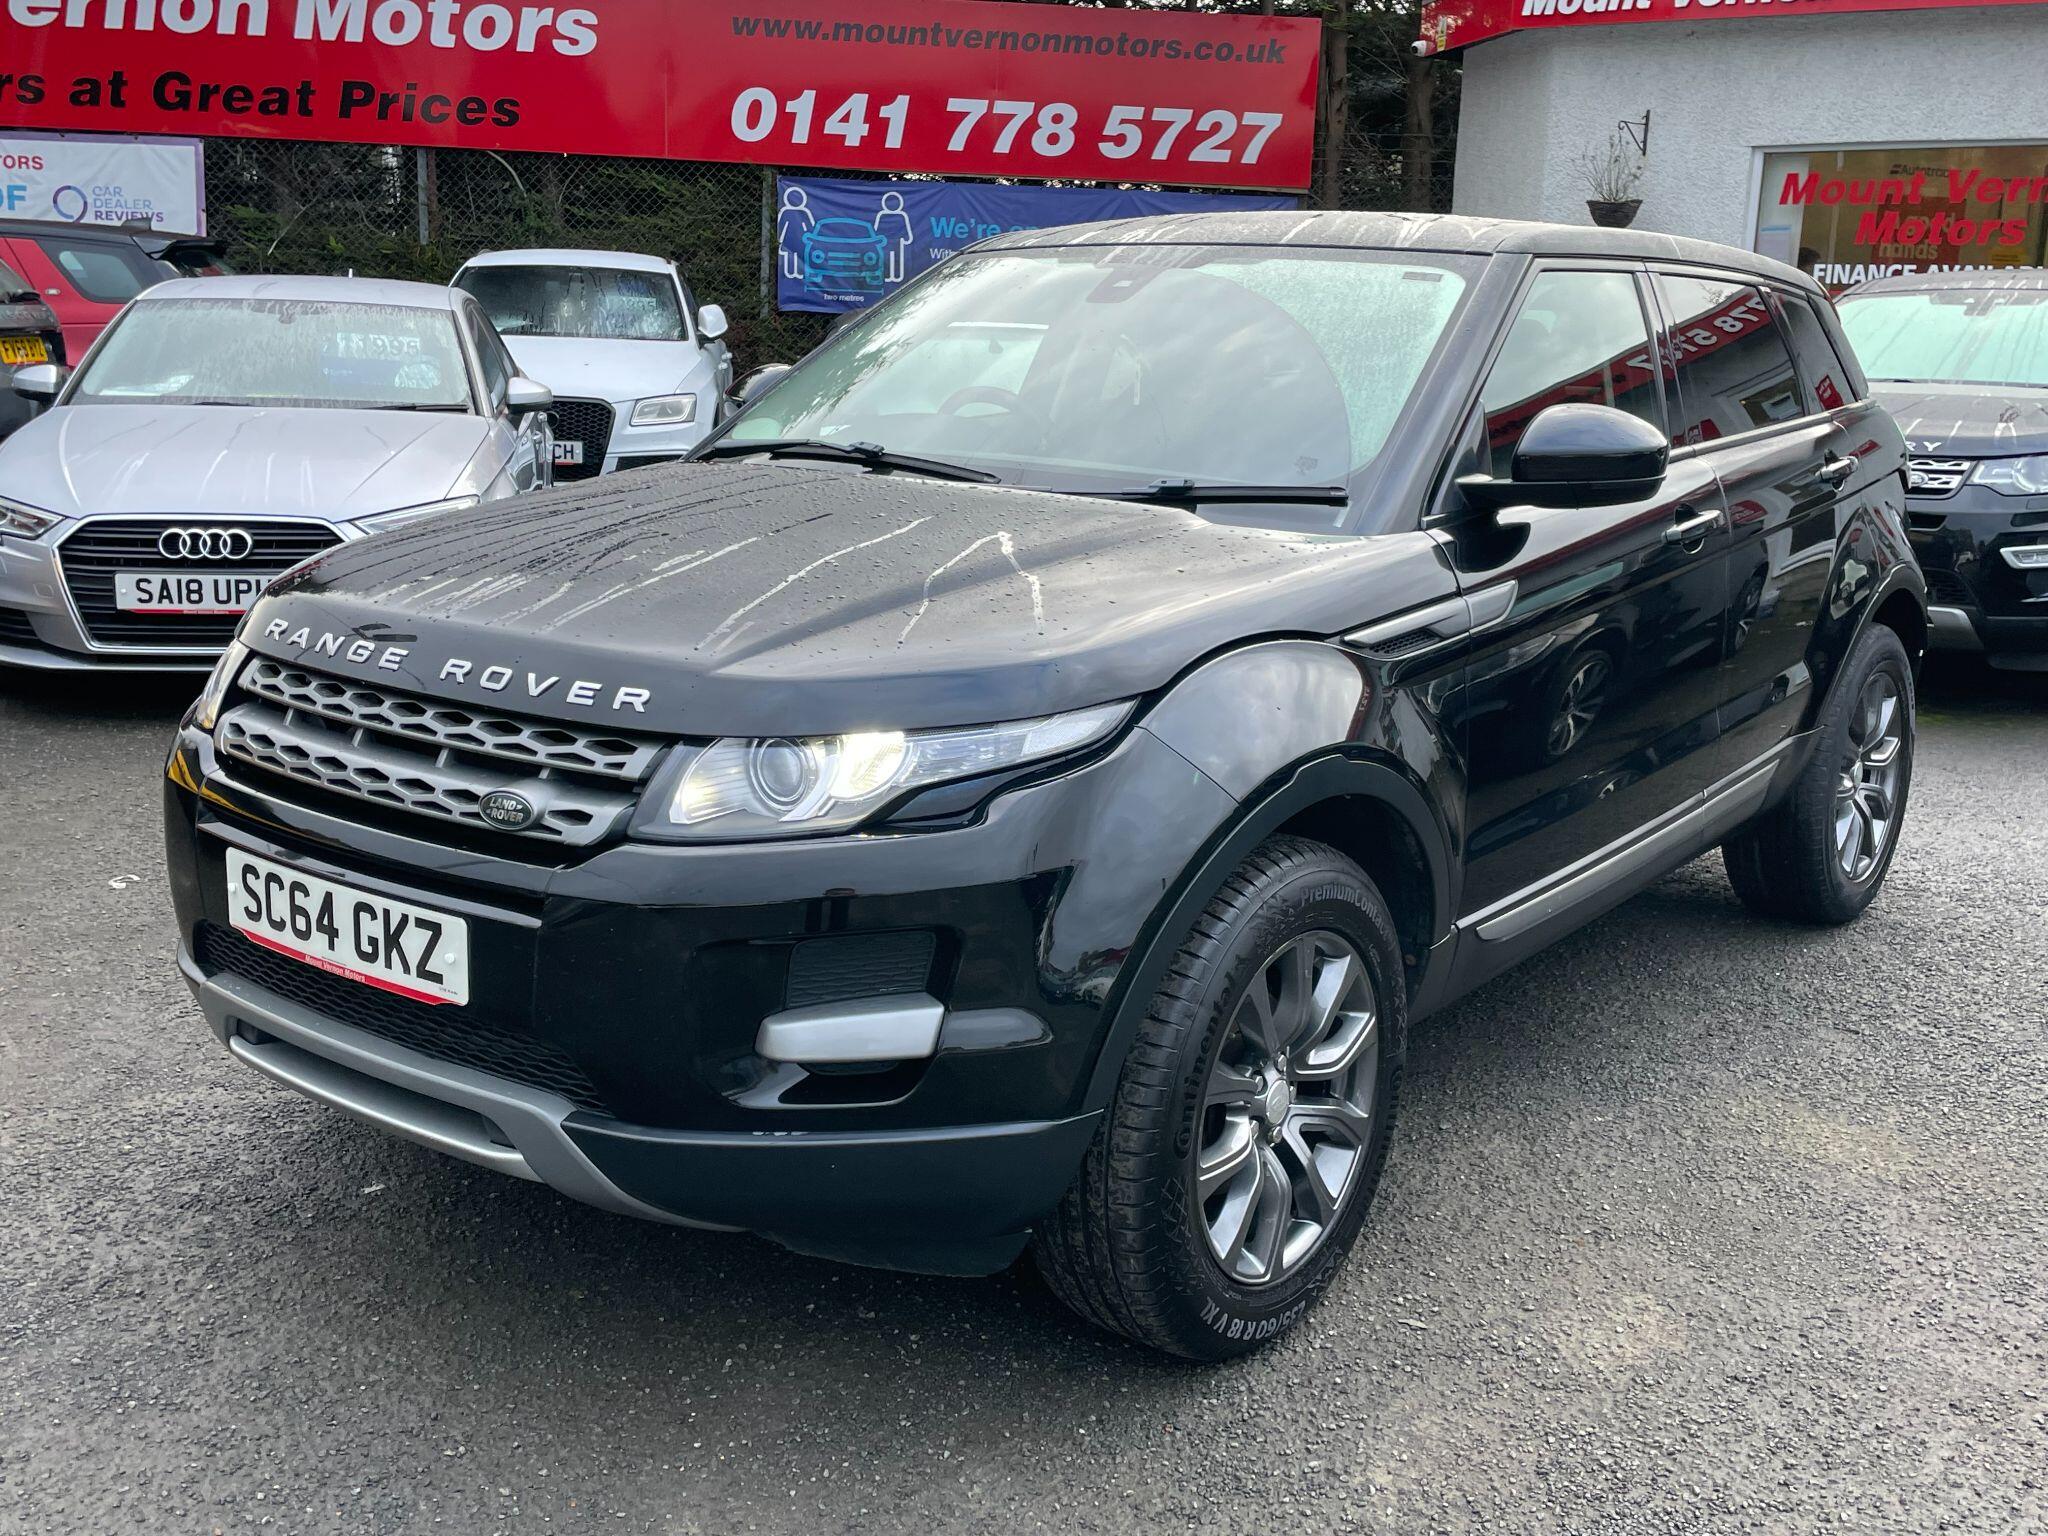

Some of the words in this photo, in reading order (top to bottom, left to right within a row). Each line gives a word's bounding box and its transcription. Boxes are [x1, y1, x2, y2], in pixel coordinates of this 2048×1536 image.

[293, 0, 598, 56] Motors
[732, 16, 1289, 64] www.mountvernonmotors.co.uk
[69, 70, 128, 108] at
[153, 70, 316, 117] Great
[338, 80, 520, 127] Prices
[731, 87, 910, 149] 0141
[946, 98, 1078, 157] 778
[1097, 105, 1283, 164] 5727
[0, 155, 44, 170] ORS
[0, 184, 27, 211] F
[92, 186, 124, 198] CAR
[1779, 171, 1926, 206] Mount
[93, 199, 153, 210] DEALER
[1853, 210, 2028, 246] Motors
[135, 578, 204, 605] SA18
[264, 618, 409, 671] RANGE
[440, 658, 651, 713] ROVER
[490, 797, 517, 811] LAND
[491, 808, 524, 823] ROVER
[241, 863, 339, 952] SC64
[353, 901, 444, 985] GKZ
[344, 967, 366, 983] Motors
[1199, 1296, 1220, 1325] XL
